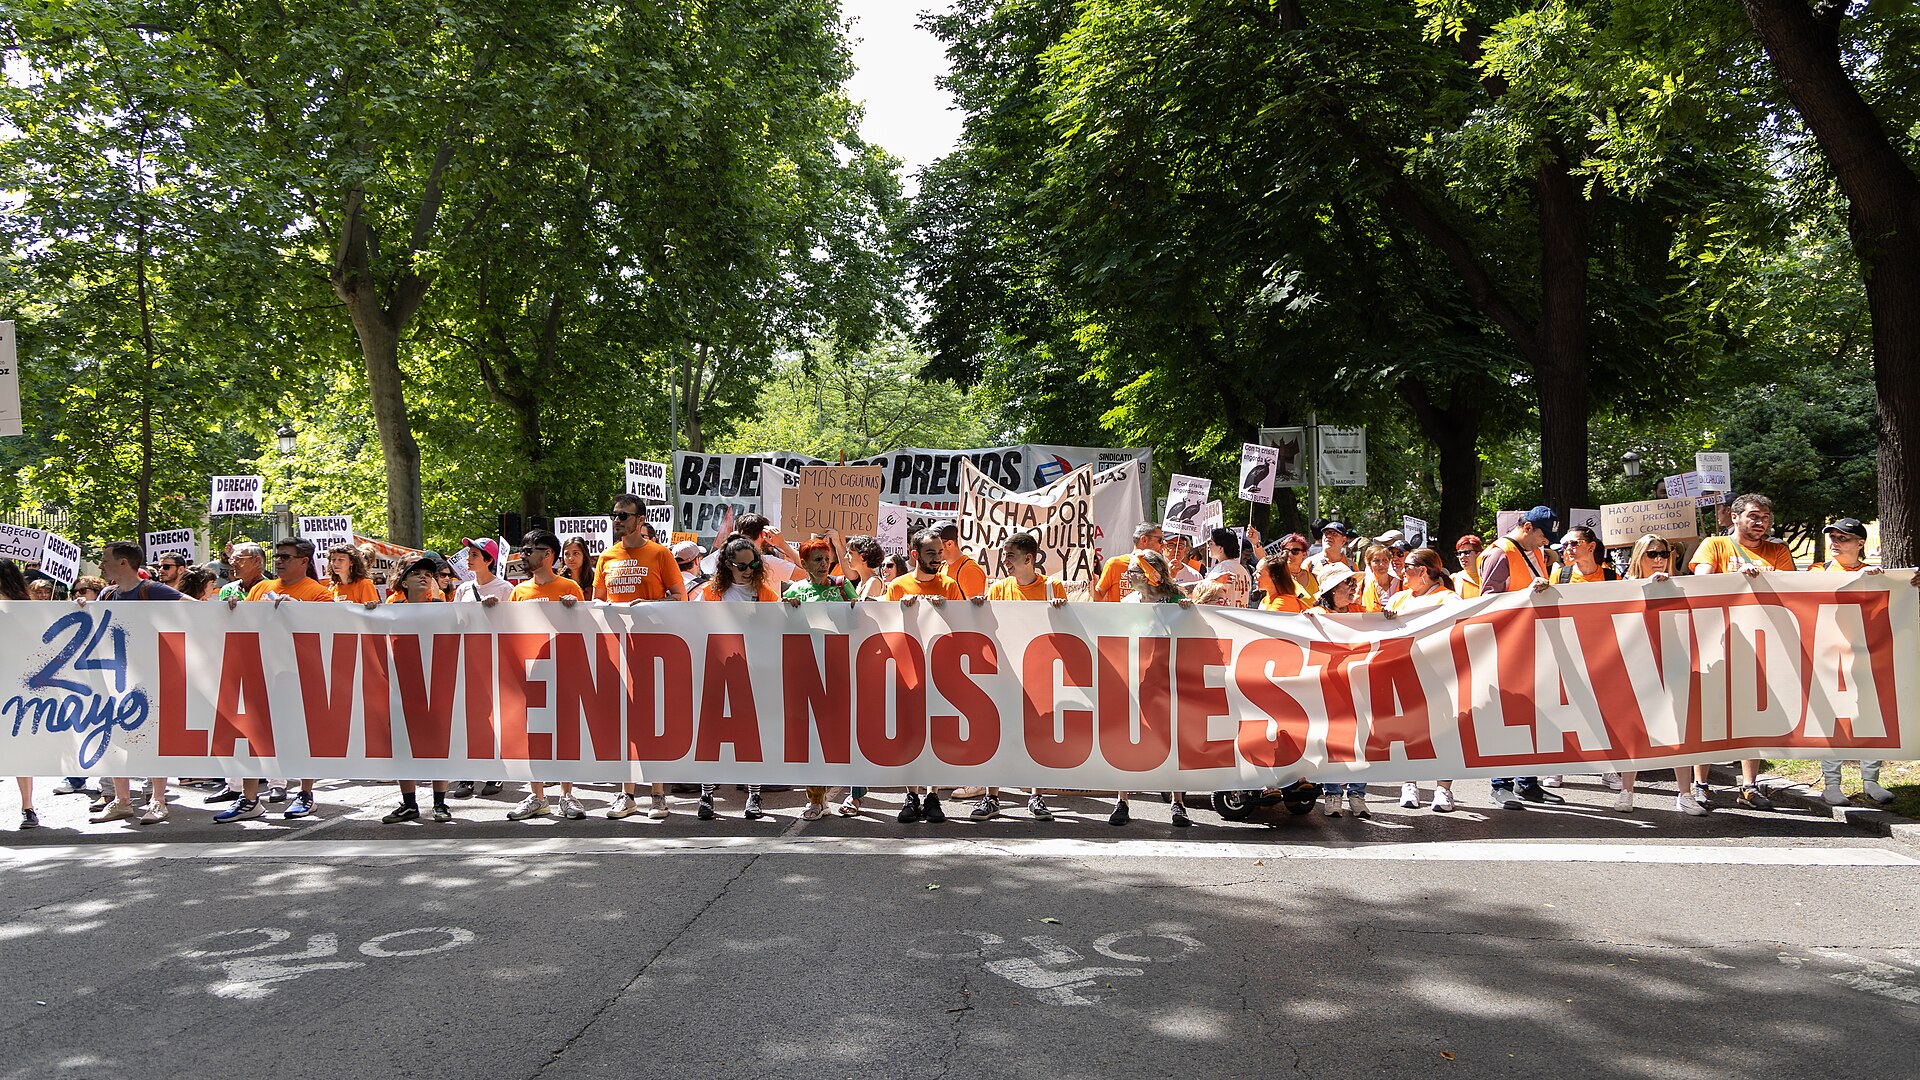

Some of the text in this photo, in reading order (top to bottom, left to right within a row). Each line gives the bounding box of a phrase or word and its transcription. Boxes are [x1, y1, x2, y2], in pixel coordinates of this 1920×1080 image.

[1098, 453, 1132, 461] SINDICATO
[629, 461, 662, 479] DERECHO
[803, 467, 837, 488] MÁS
[217, 478, 258, 492] DERECHO
[631, 481, 663, 499] A TECHO.
[216, 498, 257, 512] A TECHO.
[814, 491, 870, 508] Y MENOS
[1608, 500, 1691, 515] HAY QUE BAJAR
[1704, 496, 1723, 505] MADID
[646, 507, 671, 523] RECHO
[805, 508, 874, 531] BUITRES
[1047, 500, 1089, 526] POR
[1616, 516, 1635, 524] LOS
[0, 524, 40, 540] ERECHO
[304, 518, 348, 532] DERECHO
[559, 519, 608, 534] DERECHO
[1625, 526, 1635, 534] EL
[1640, 521, 1691, 533] CORREDOR
[12, 537, 21, 545] A
[149, 530, 190, 546] DERECHO
[0, 543, 37, 560] ECHO!
[47, 535, 78, 562] DERECHO
[152, 551, 159, 562] A
[44, 558, 74, 584] A TECHO.
[1056, 548, 1093, 581] YA
[614, 585, 636, 594] MADRID
[28, 608, 130, 696] 24
[158, 603, 1888, 772] LA VIVIENDA NOS CUESTA LA VIDA
[1, 687, 149, 770] mayo
